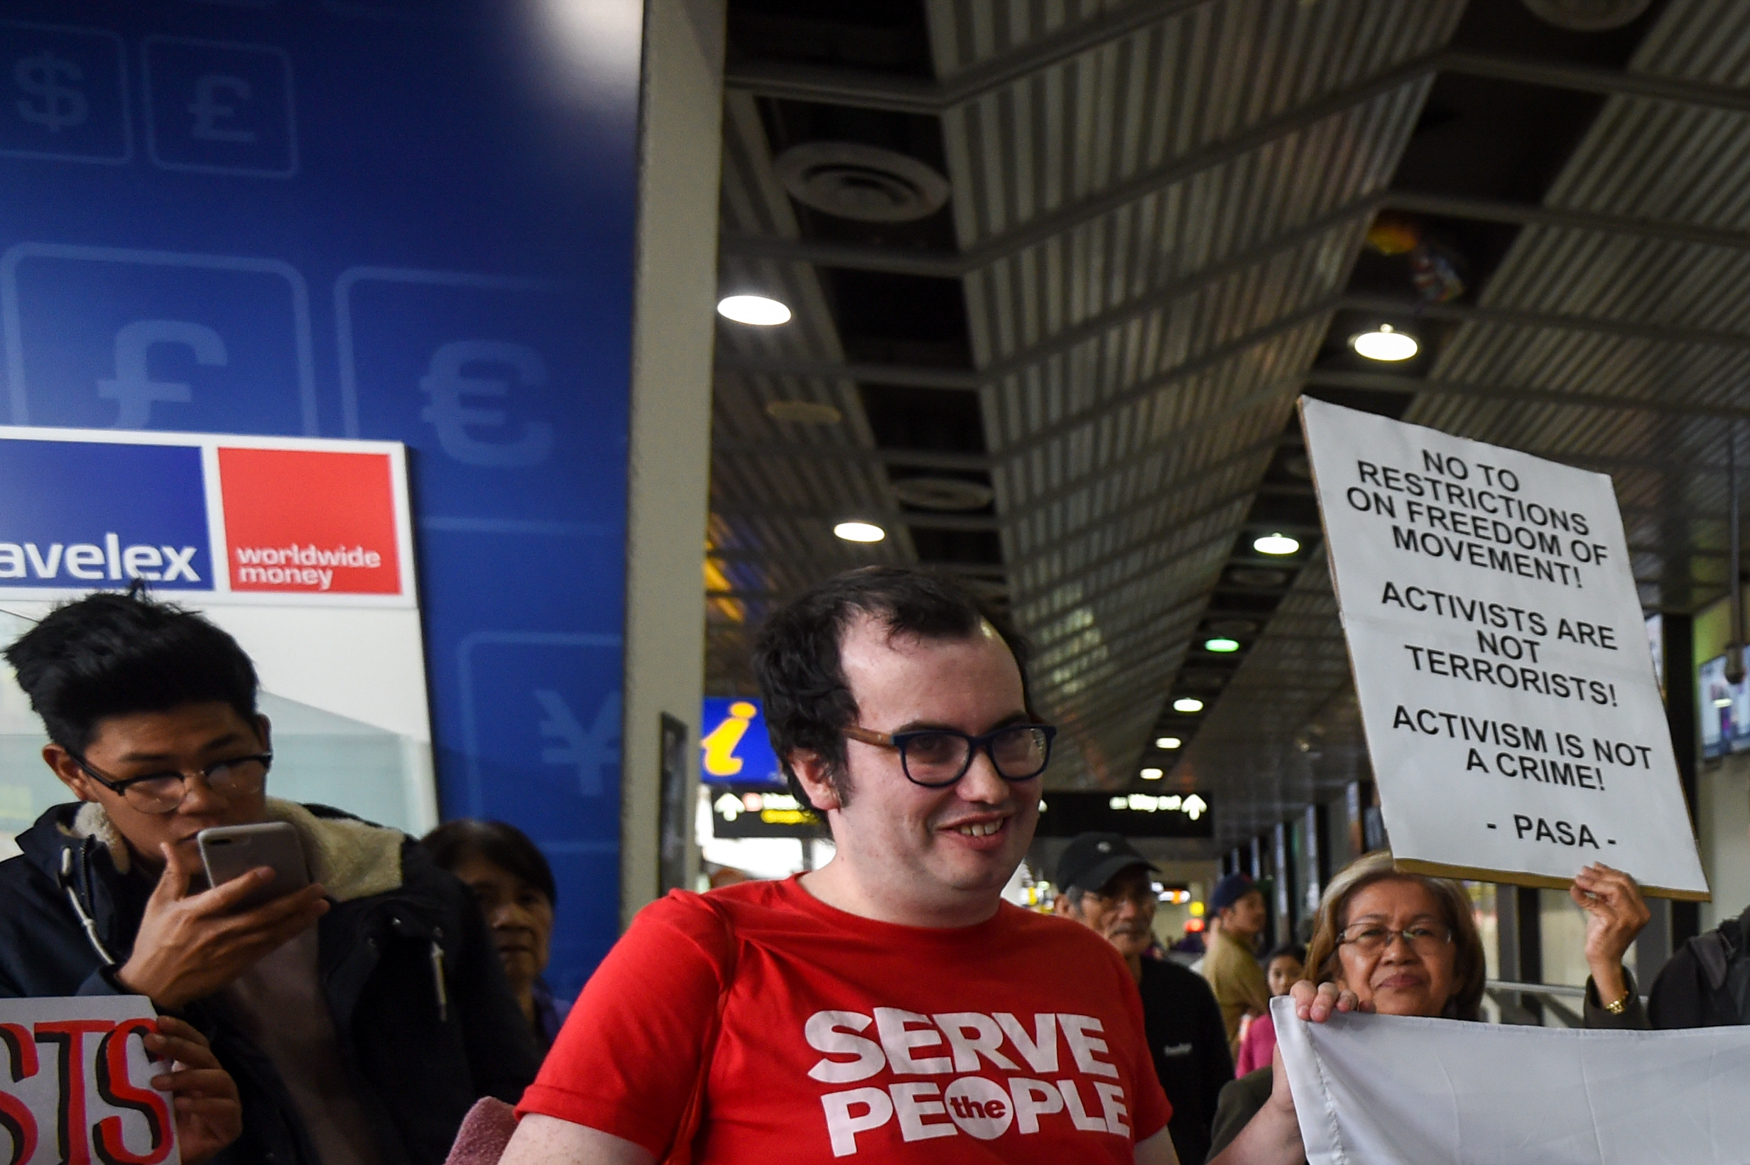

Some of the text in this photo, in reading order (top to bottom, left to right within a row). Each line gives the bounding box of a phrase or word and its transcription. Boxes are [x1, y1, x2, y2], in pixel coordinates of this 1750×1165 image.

[1357, 459, 1590, 536] RESTRICTIONS
[1422, 449, 1519, 492] NO TO
[236, 543, 381, 569] worldwide
[1347, 486, 1608, 566] ON FREEDOM OF
[1392, 524, 1583, 589] MOVEMENT!
[238, 566, 334, 591] money
[1381, 581, 1618, 651] ACTIVISTS ARE
[1476, 629, 1541, 664] NOT
[1404, 644, 1618, 707] TERRORISTS!
[1392, 704, 1652, 769] ACTIVISM IS NOT
[1466, 747, 1606, 791] A CRIME!
[1513, 814, 1601, 850] PASA
[804, 1006, 1119, 1083] SERVE
[820, 1076, 1131, 1158] PEOPLE
[949, 1096, 1007, 1120] the
